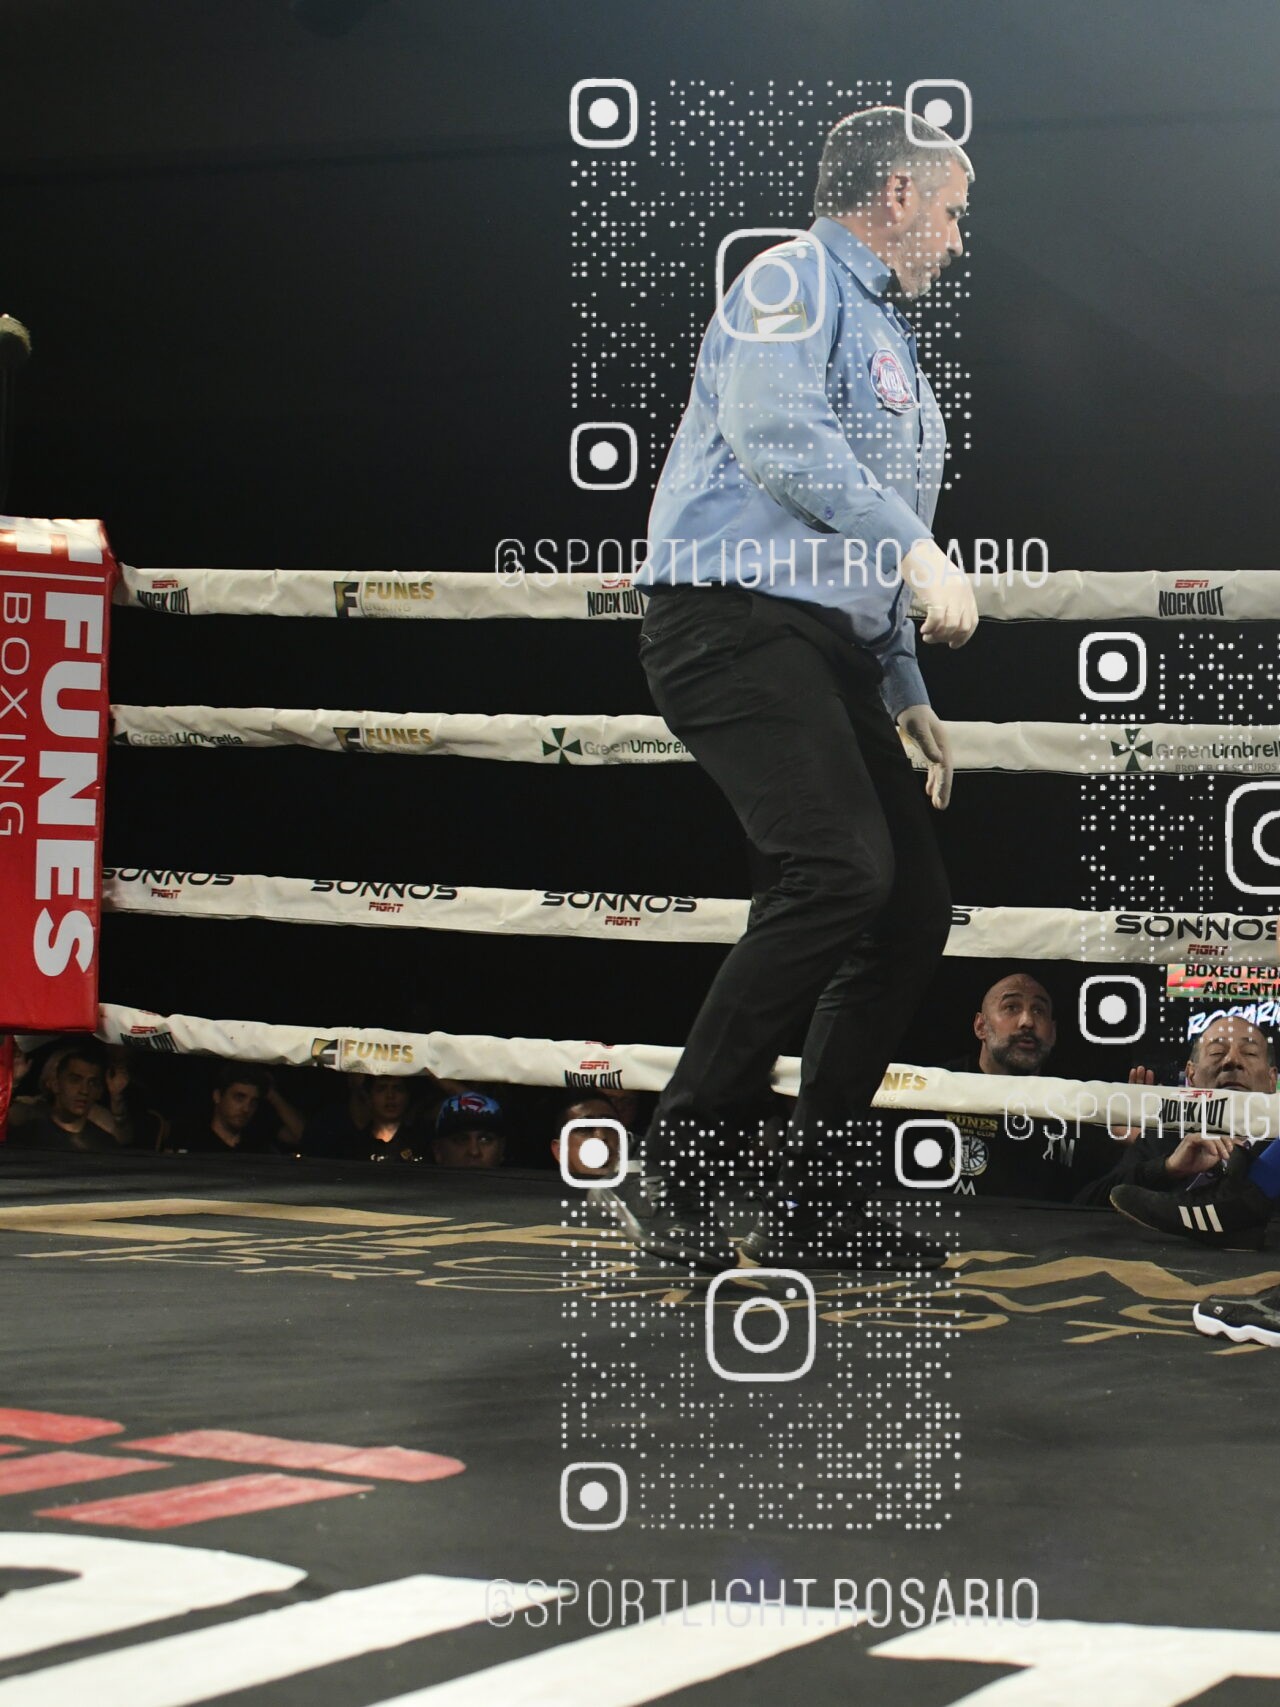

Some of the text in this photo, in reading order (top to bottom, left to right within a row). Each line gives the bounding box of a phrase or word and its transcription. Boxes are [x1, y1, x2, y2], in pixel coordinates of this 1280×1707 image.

[364, 581, 435, 600] FUNES
[1174, 579, 1209, 589] ESPN
[1197, 585, 1224, 616] OUT
[0, 592, 31, 837] BOXING
[365, 728, 432, 745] FUNES
[33, 591, 104, 977] FUNES
[368, 901, 403, 914] FIGHT
[605, 915, 641, 927] FIGHT
[1187, 943, 1228, 956] FIGHT
[1185, 963, 1242, 978] BOXEO
[343, 1039, 414, 1063] FUNES
[580, 1061, 610, 1070] ESPN
